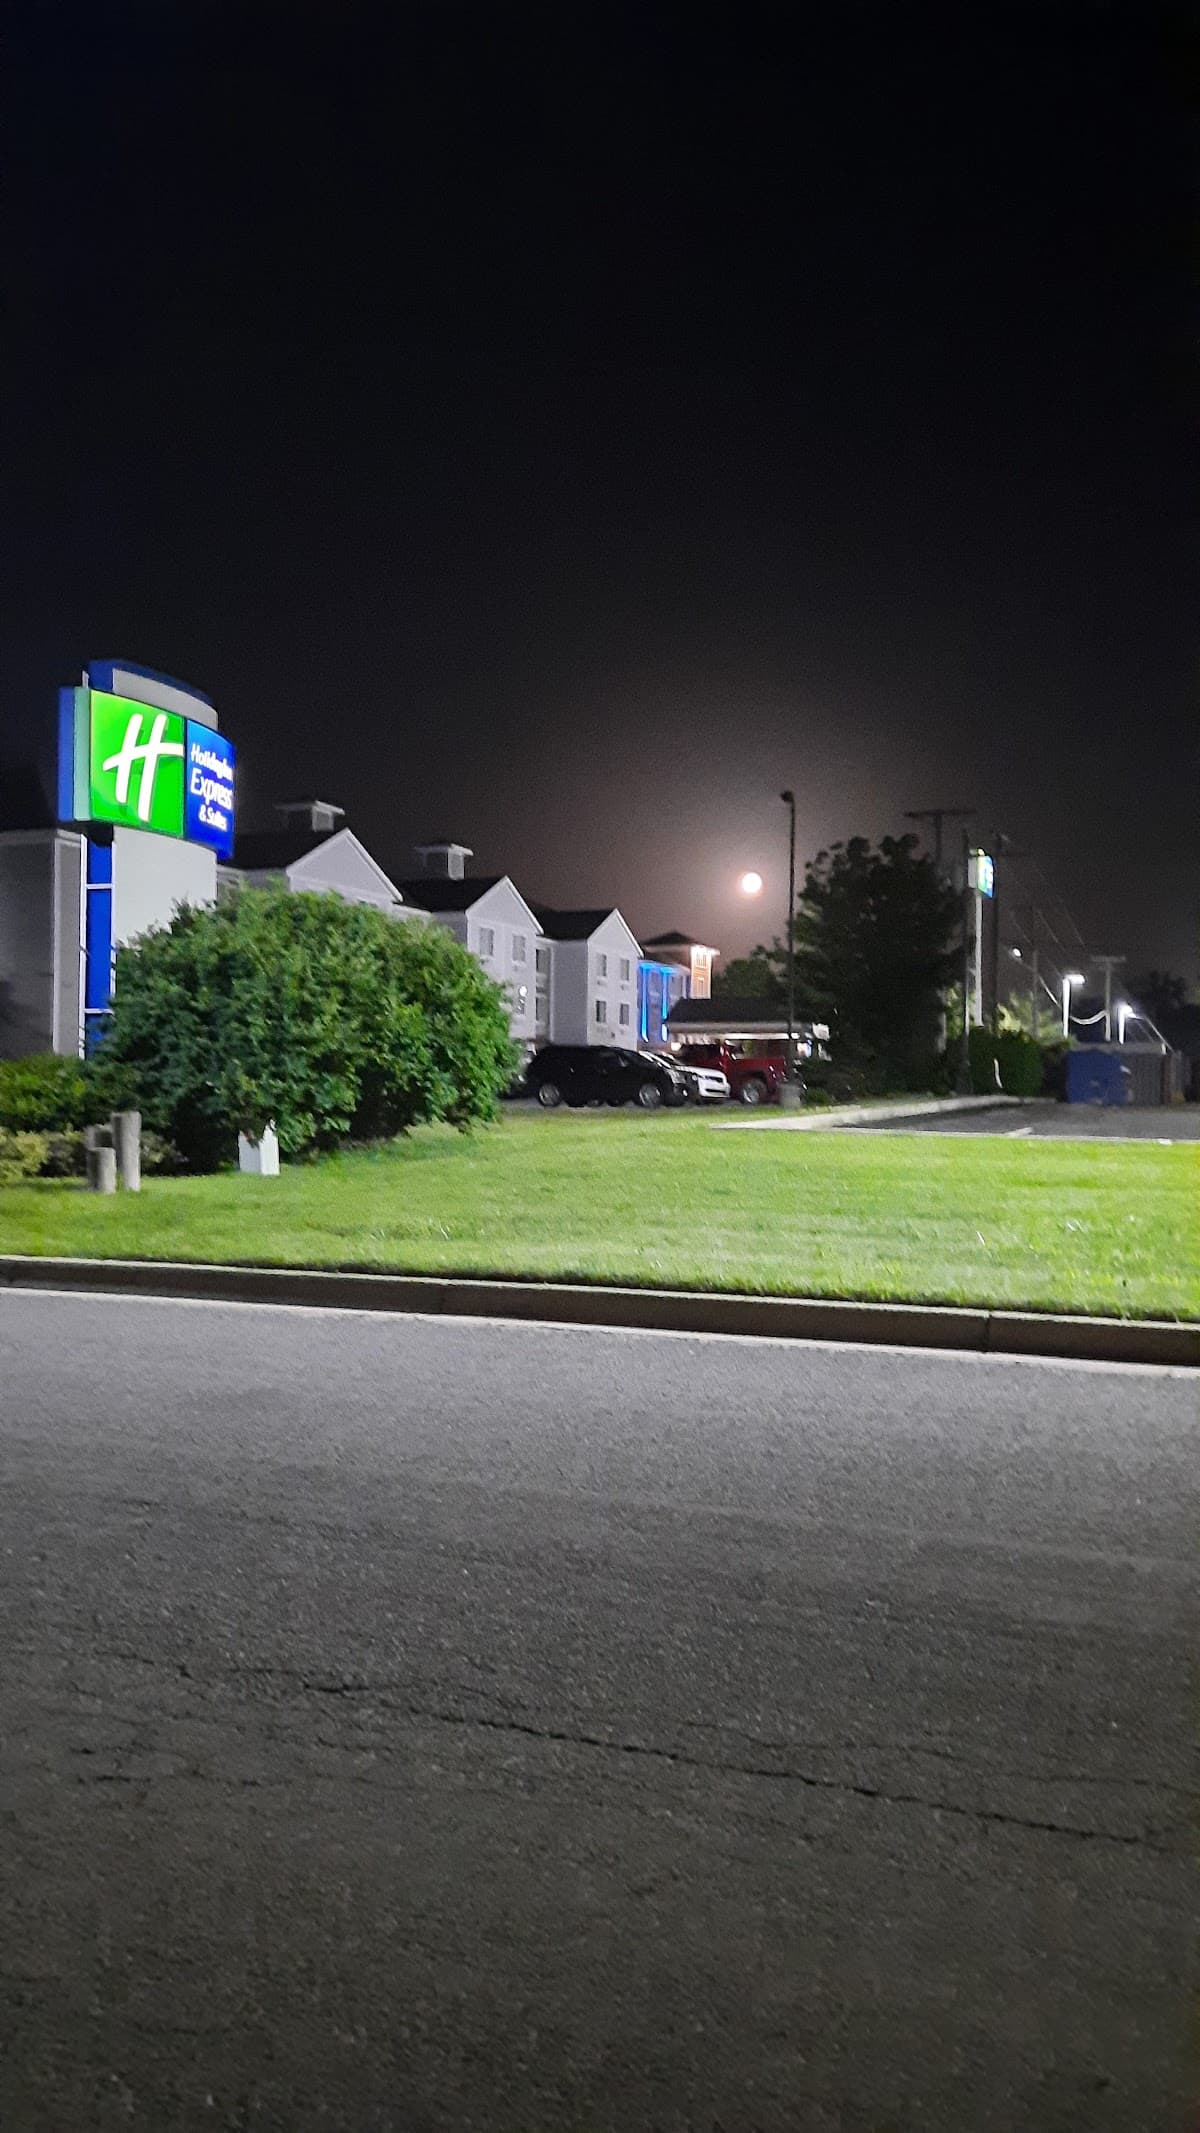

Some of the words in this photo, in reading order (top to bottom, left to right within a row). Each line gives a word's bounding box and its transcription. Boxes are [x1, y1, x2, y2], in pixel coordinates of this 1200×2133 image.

[102, 713, 184, 822] H
[190, 767, 233, 810] Express
[198, 804, 207, 822] &
